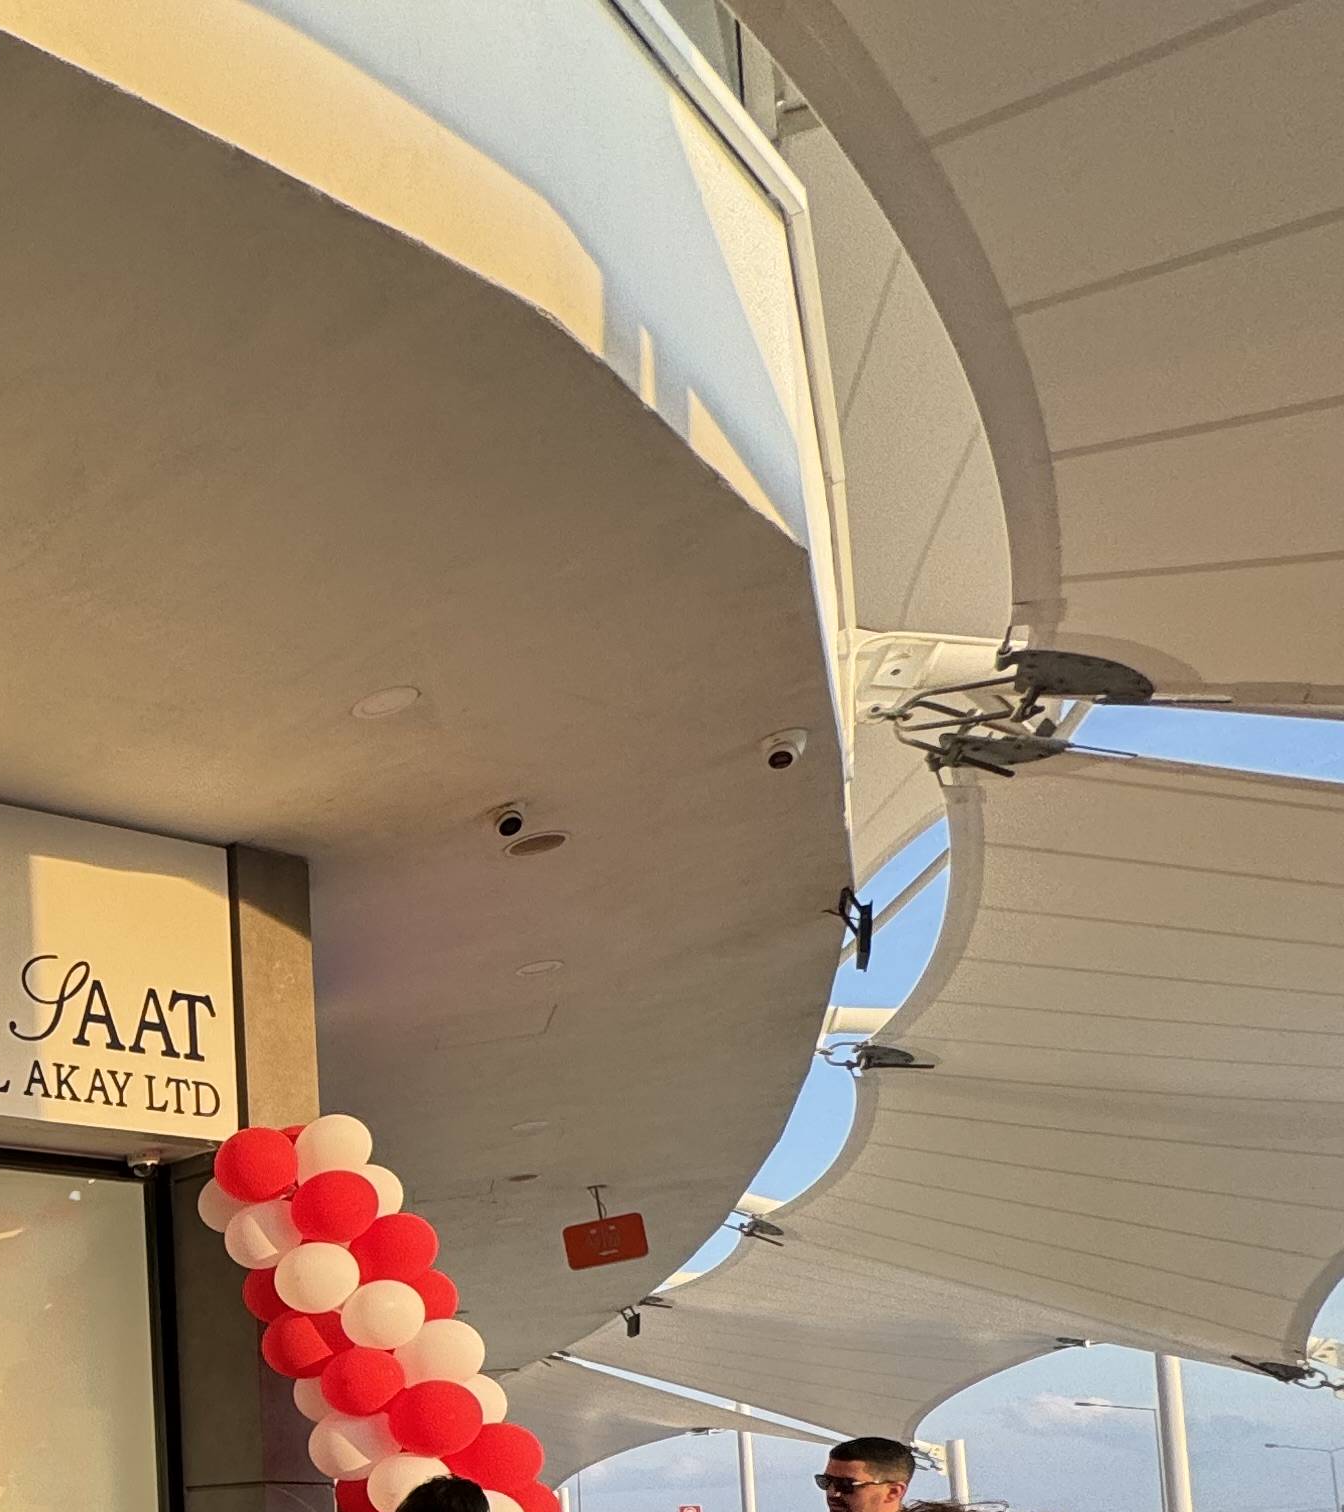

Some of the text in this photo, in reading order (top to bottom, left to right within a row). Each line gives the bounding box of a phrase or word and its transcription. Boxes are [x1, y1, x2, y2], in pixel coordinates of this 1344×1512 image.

[9, 953, 217, 1063] SAAT
[25, 1062, 134, 1109] AKAY
[145, 1073, 222, 1119] LTD
